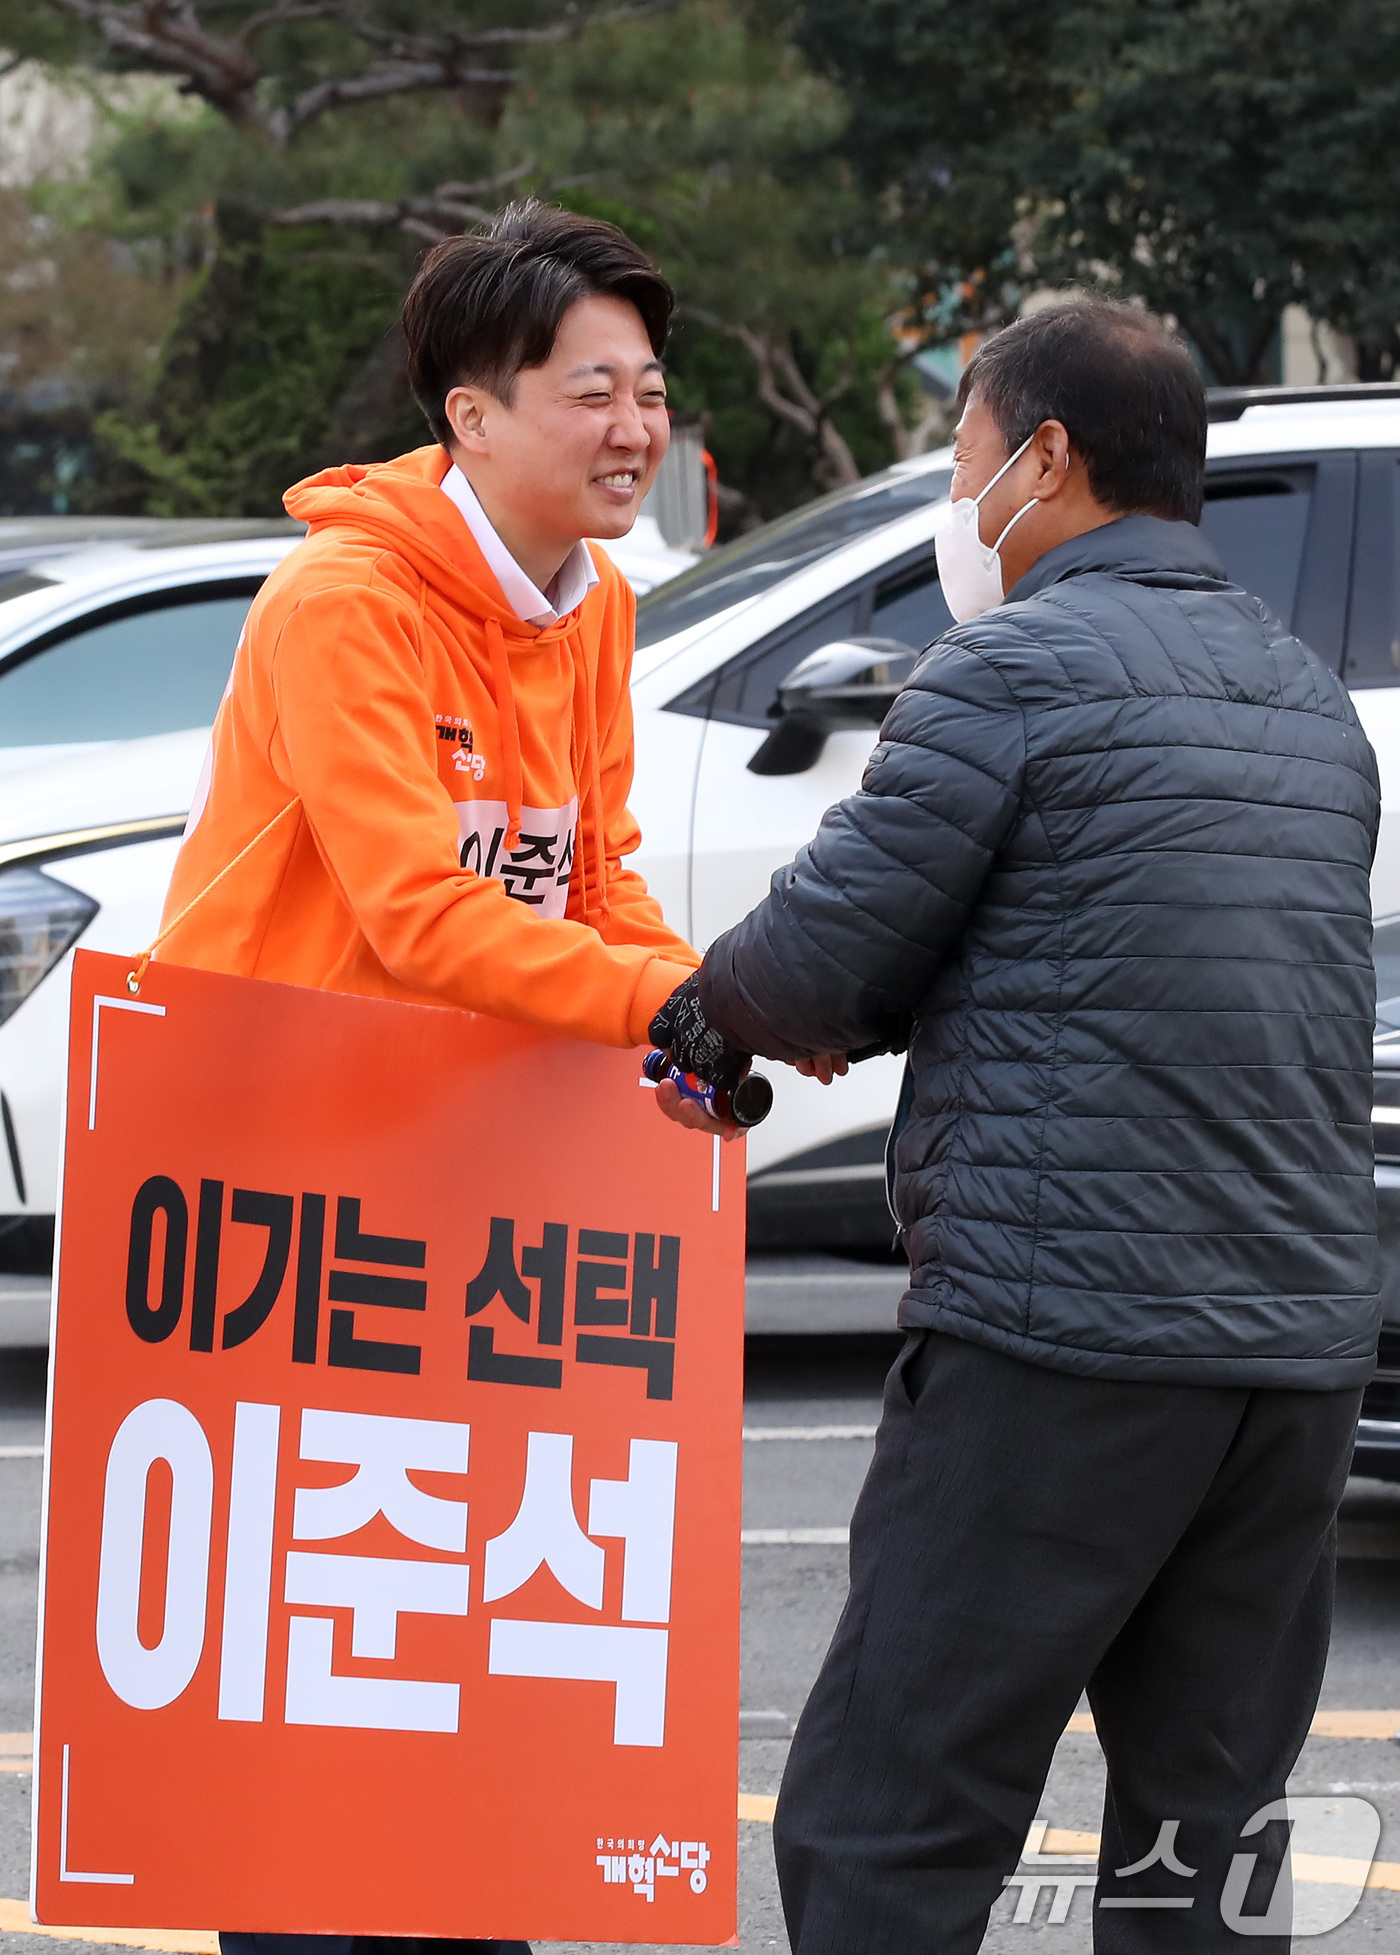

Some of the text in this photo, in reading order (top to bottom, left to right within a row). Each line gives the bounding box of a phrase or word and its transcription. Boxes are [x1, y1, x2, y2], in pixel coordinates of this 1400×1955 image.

[125, 1174, 682, 1401] 이기는 선택
[95, 1397, 679, 1748] 이준석
[596, 1833, 711, 1902] 개혁신당
